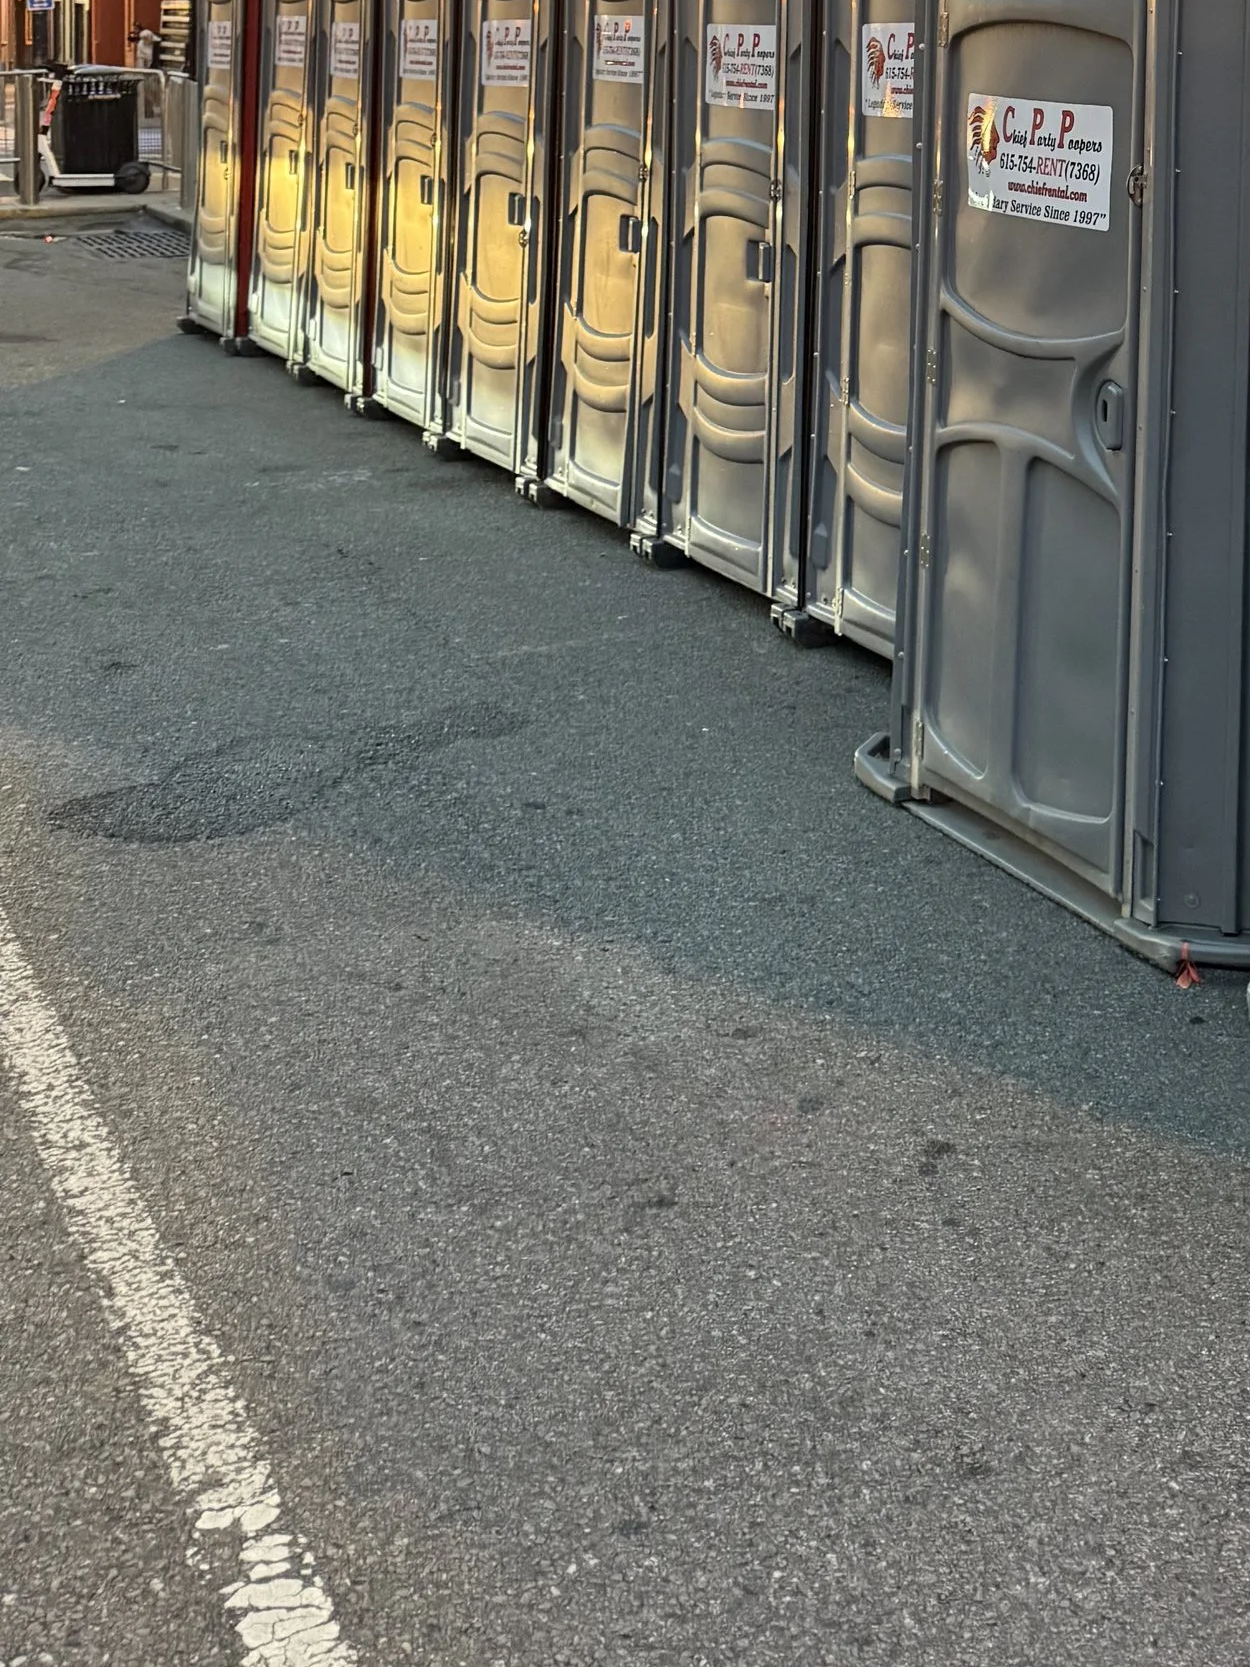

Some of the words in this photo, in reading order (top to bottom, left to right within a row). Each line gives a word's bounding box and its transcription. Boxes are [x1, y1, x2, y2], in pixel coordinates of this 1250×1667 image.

[1002, 106, 1028, 148] Chief
[1029, 108, 1056, 152] Party
[1057, 110, 1102, 155] Poopers
[1000, 152, 1100, 186] 615-754-RENT(7368)
[1010, 199, 1042, 216] Service
[1044, 205, 1070, 221] Since
